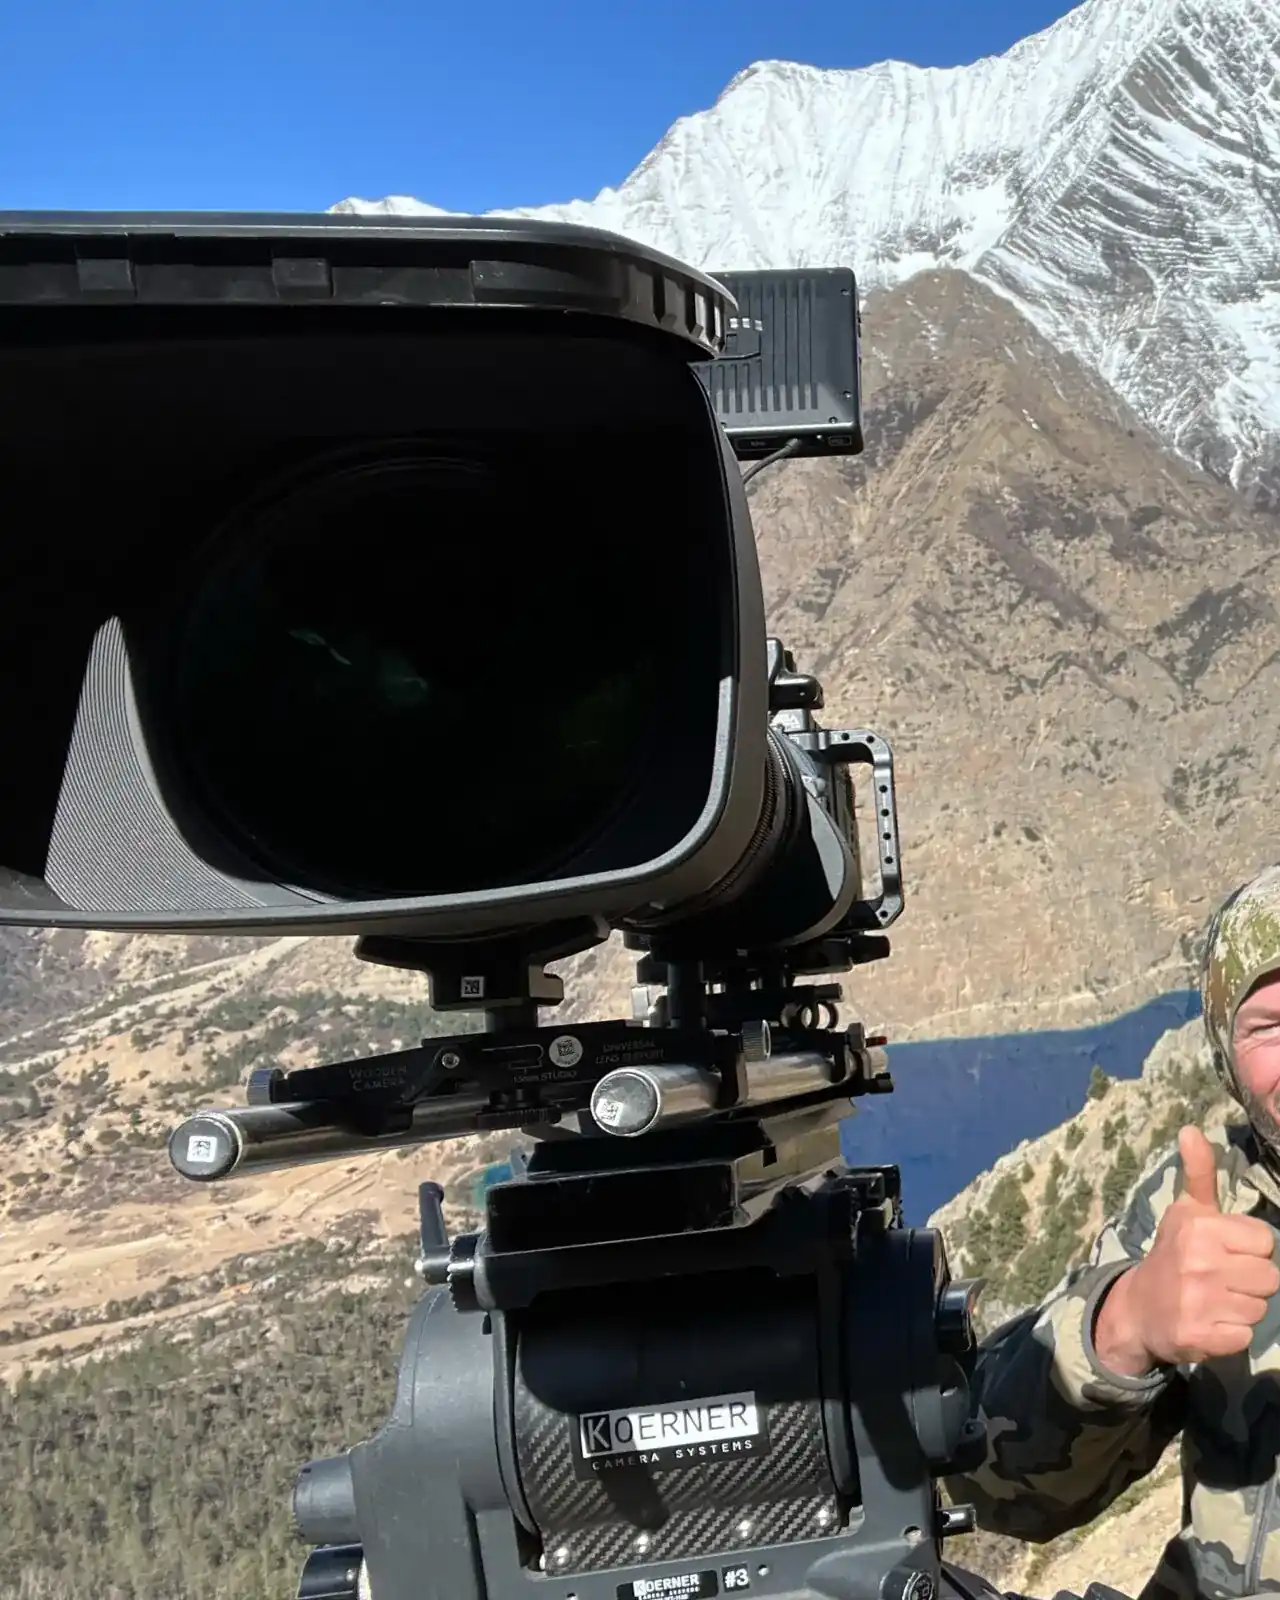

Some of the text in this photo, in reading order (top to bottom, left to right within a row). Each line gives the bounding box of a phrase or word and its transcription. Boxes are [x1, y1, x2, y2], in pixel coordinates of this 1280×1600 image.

[584, 1401, 750, 1450] KOERNER
[592, 1440, 753, 1471] CAMERA SYSTEMS
[632, 1573, 700, 1597] KOERNER
[725, 1568, 749, 1589] #3
